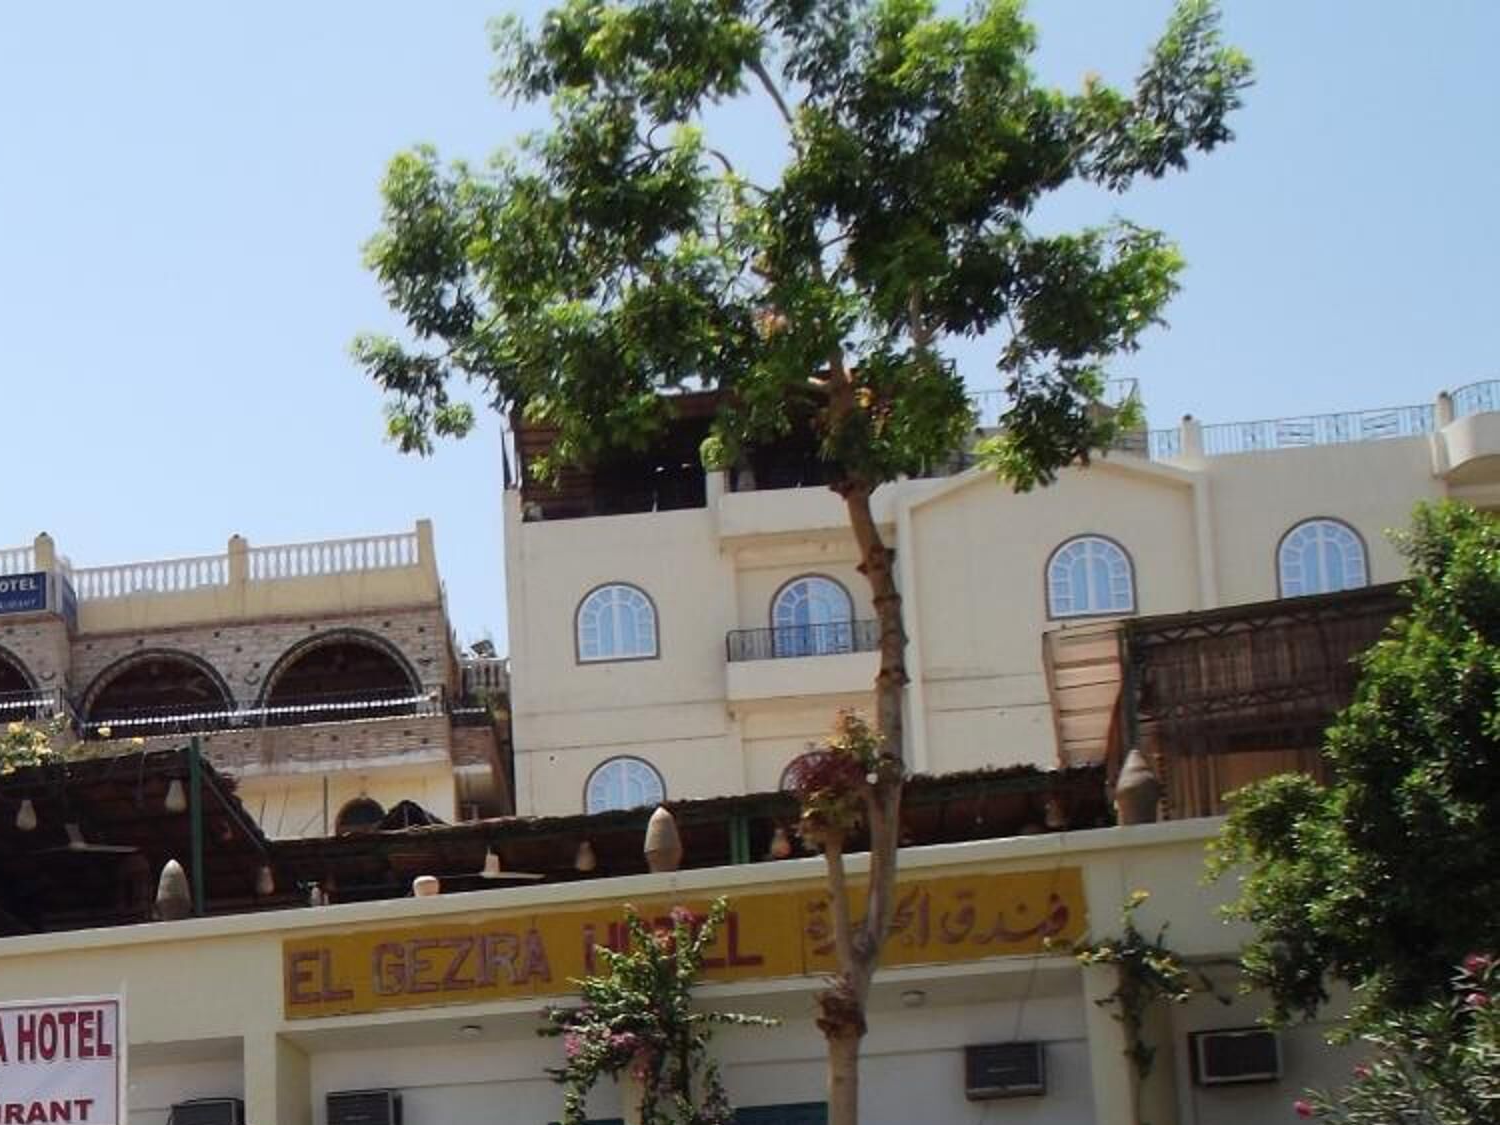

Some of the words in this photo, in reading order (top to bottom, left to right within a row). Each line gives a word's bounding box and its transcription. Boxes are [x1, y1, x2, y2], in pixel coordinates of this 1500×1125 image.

[940, 889, 1070, 946] فندق
[286, 948, 354, 1005] EL
[372, 928, 553, 997] GEZIRA
[17, 1009, 114, 1062] HOTEL
